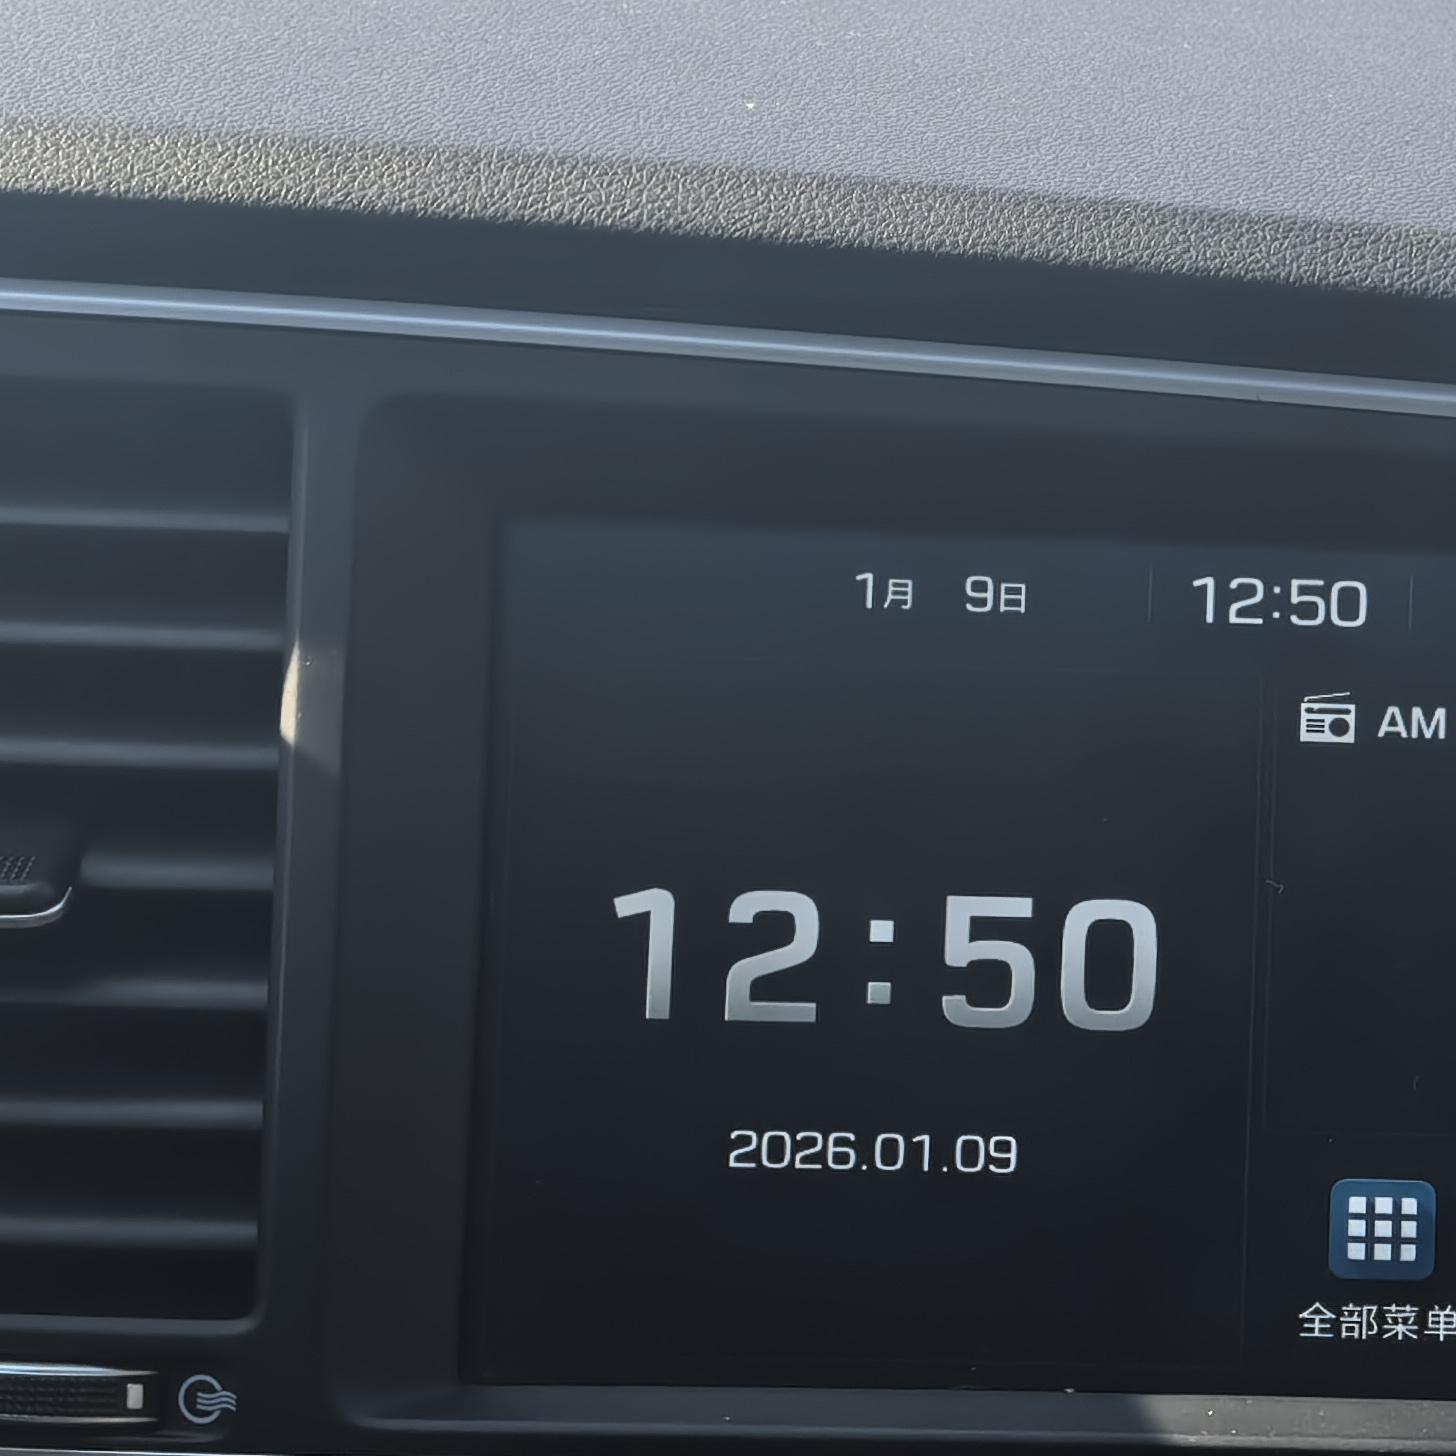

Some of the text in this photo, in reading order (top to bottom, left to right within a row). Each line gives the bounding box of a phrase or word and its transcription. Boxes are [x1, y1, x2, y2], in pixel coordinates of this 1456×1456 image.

[854, 571, 1028, 615] 1月 9日
[1191, 575, 1369, 629] 12:50
[1376, 704, 1448, 741] AM
[612, 886, 1159, 1032] 12:50
[727, 1128, 1019, 1175] 2026.01.09
